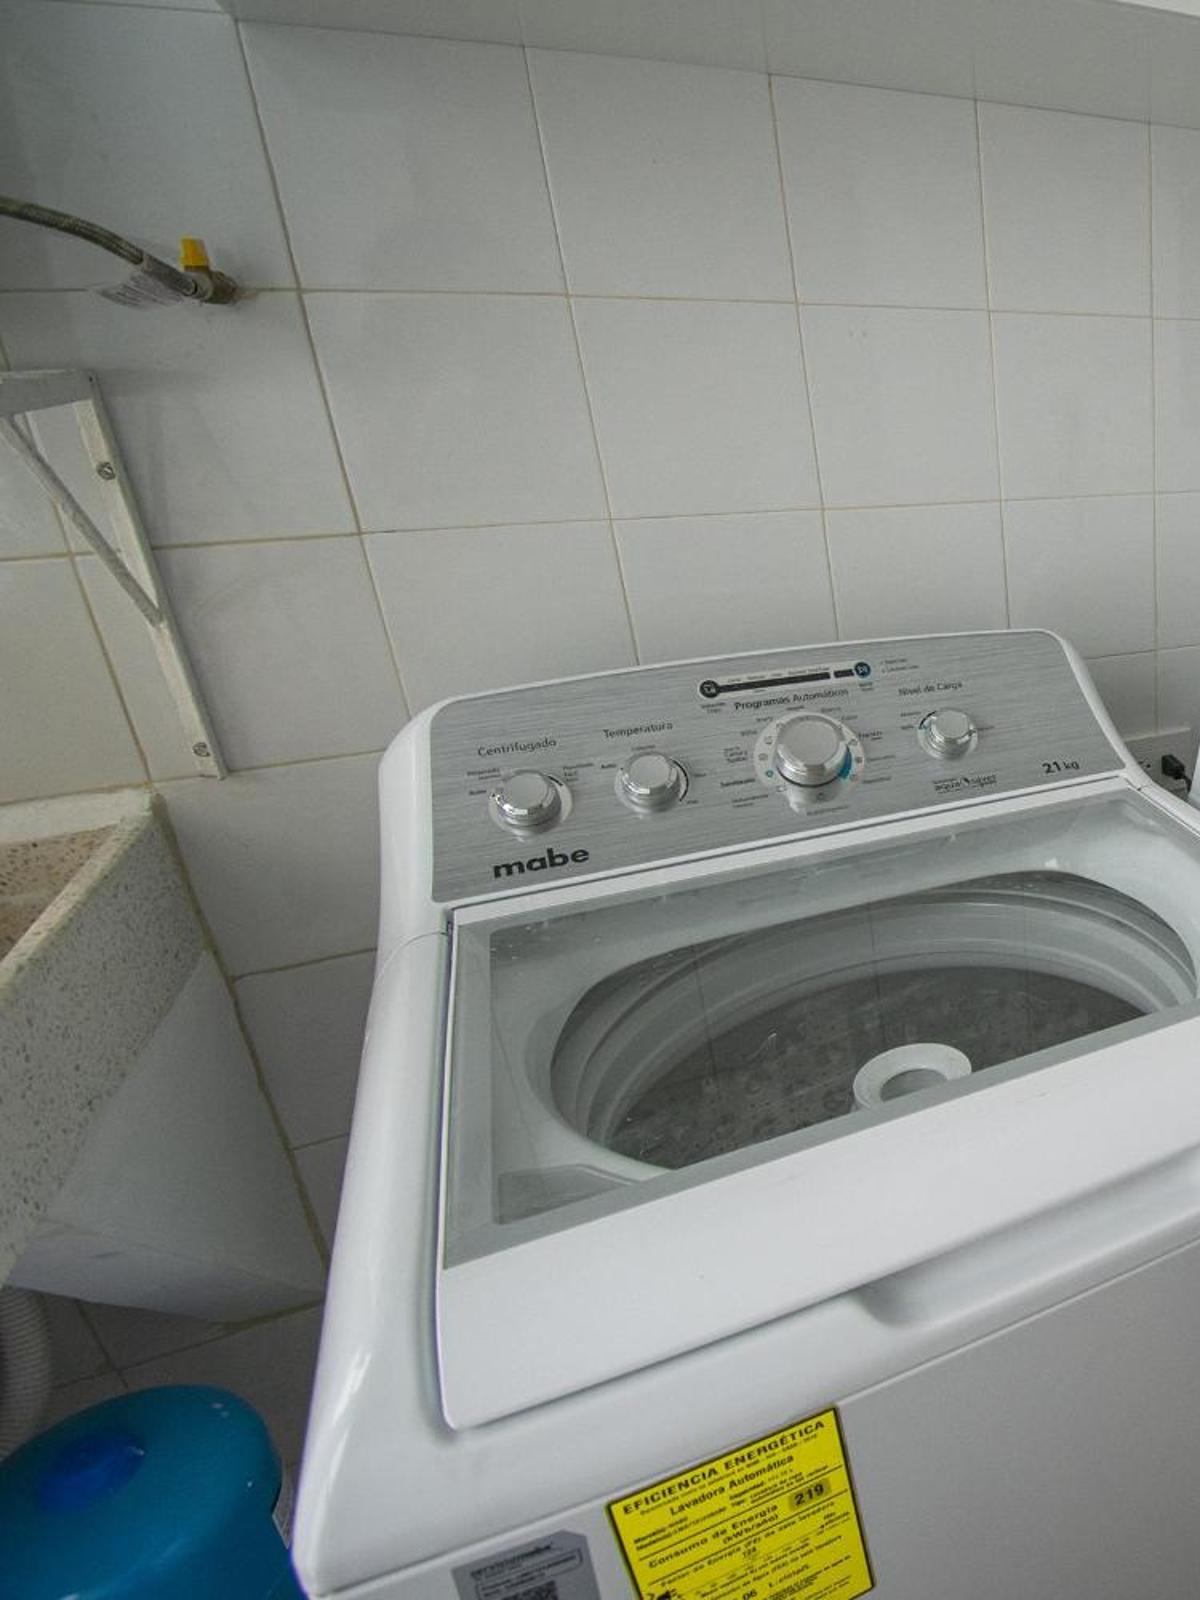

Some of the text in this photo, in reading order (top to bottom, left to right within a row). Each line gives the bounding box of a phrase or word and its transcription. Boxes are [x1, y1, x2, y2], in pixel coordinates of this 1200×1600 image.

[734, 695, 791, 711] Programas
[602, 722, 674, 739] Temperatura
[477, 738, 557, 757] Centrifugado
[1042, 760, 1080, 774] 21 kg
[493, 847, 590, 878] mabe
[622, 1467, 719, 1515] EFICIENCIA
[723, 1420, 825, 1470] ENERGÉTICA
[670, 1486, 725, 1516] Lavadora
[729, 1455, 794, 1489] Automática
[794, 1484, 824, 1506] 219
[648, 1537, 708, 1569] Consumo
[712, 1529, 728, 1540] de
[731, 1504, 778, 1531] Energía
